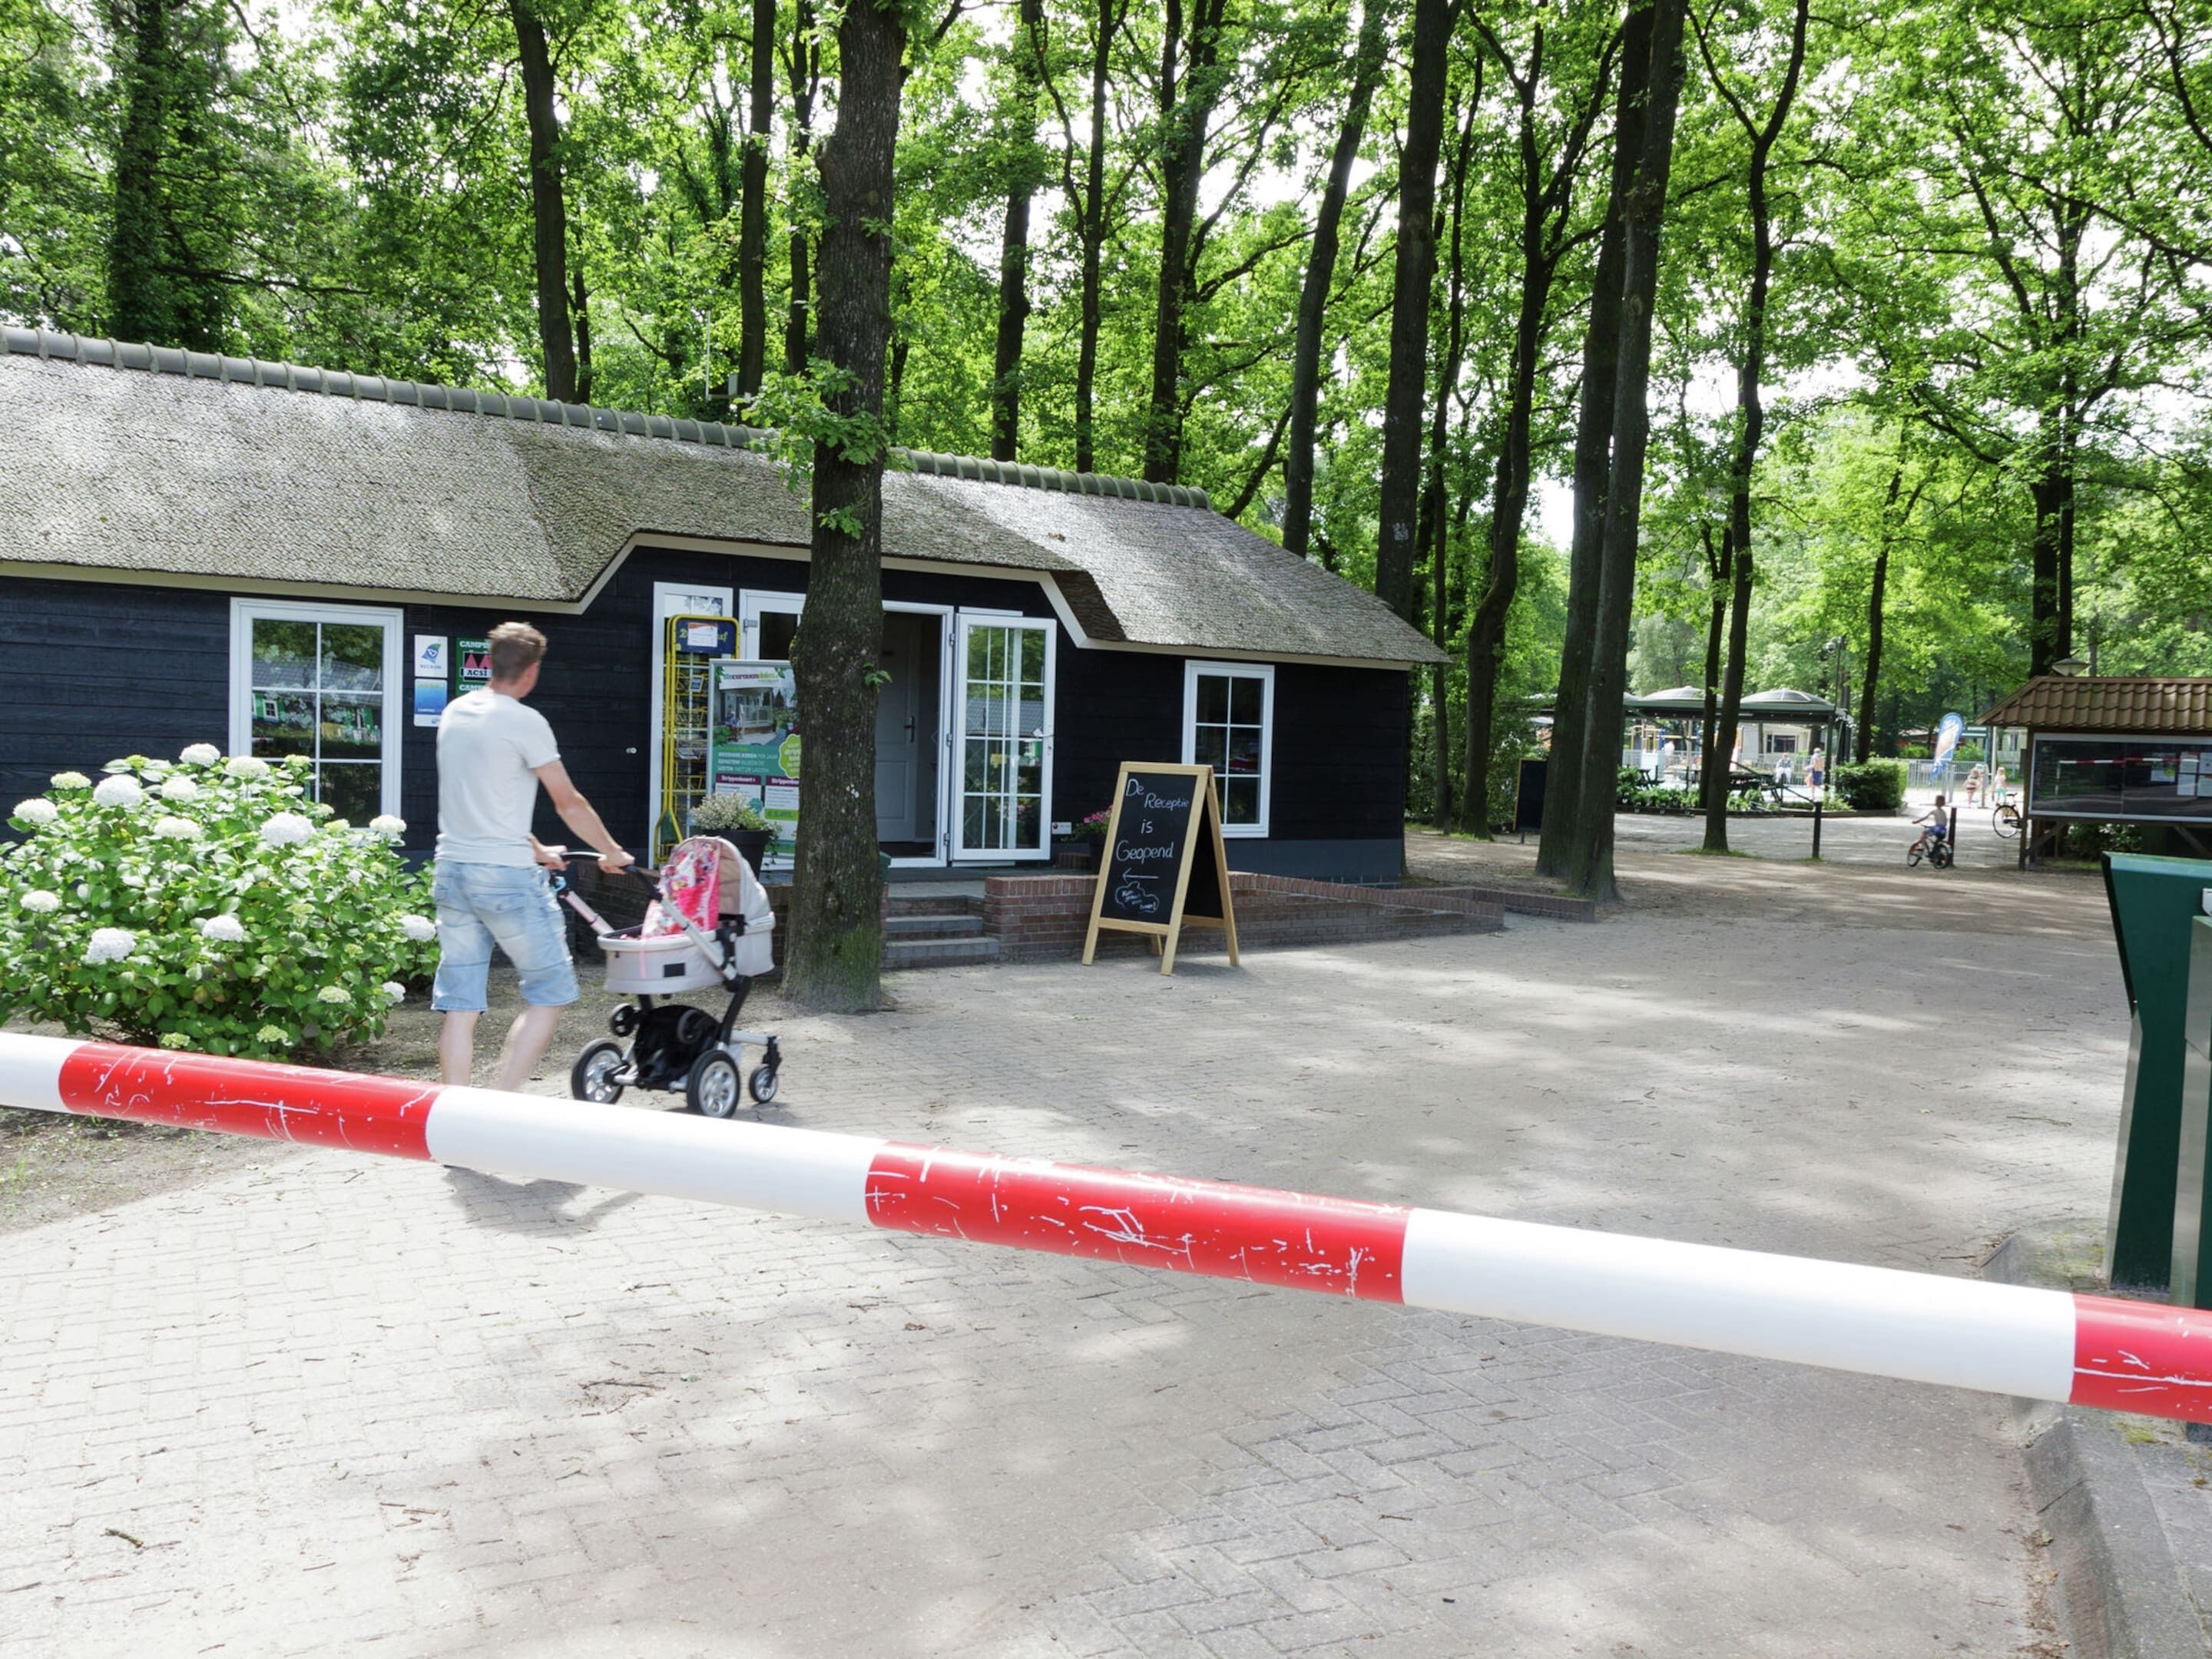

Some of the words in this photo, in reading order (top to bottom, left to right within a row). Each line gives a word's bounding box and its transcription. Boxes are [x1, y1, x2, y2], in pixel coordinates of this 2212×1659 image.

[1126, 778, 1144, 796] De
[1144, 793, 1189, 811] Receptie
[1141, 819, 1154, 834] is
[1116, 839, 1174, 864] Geopend
